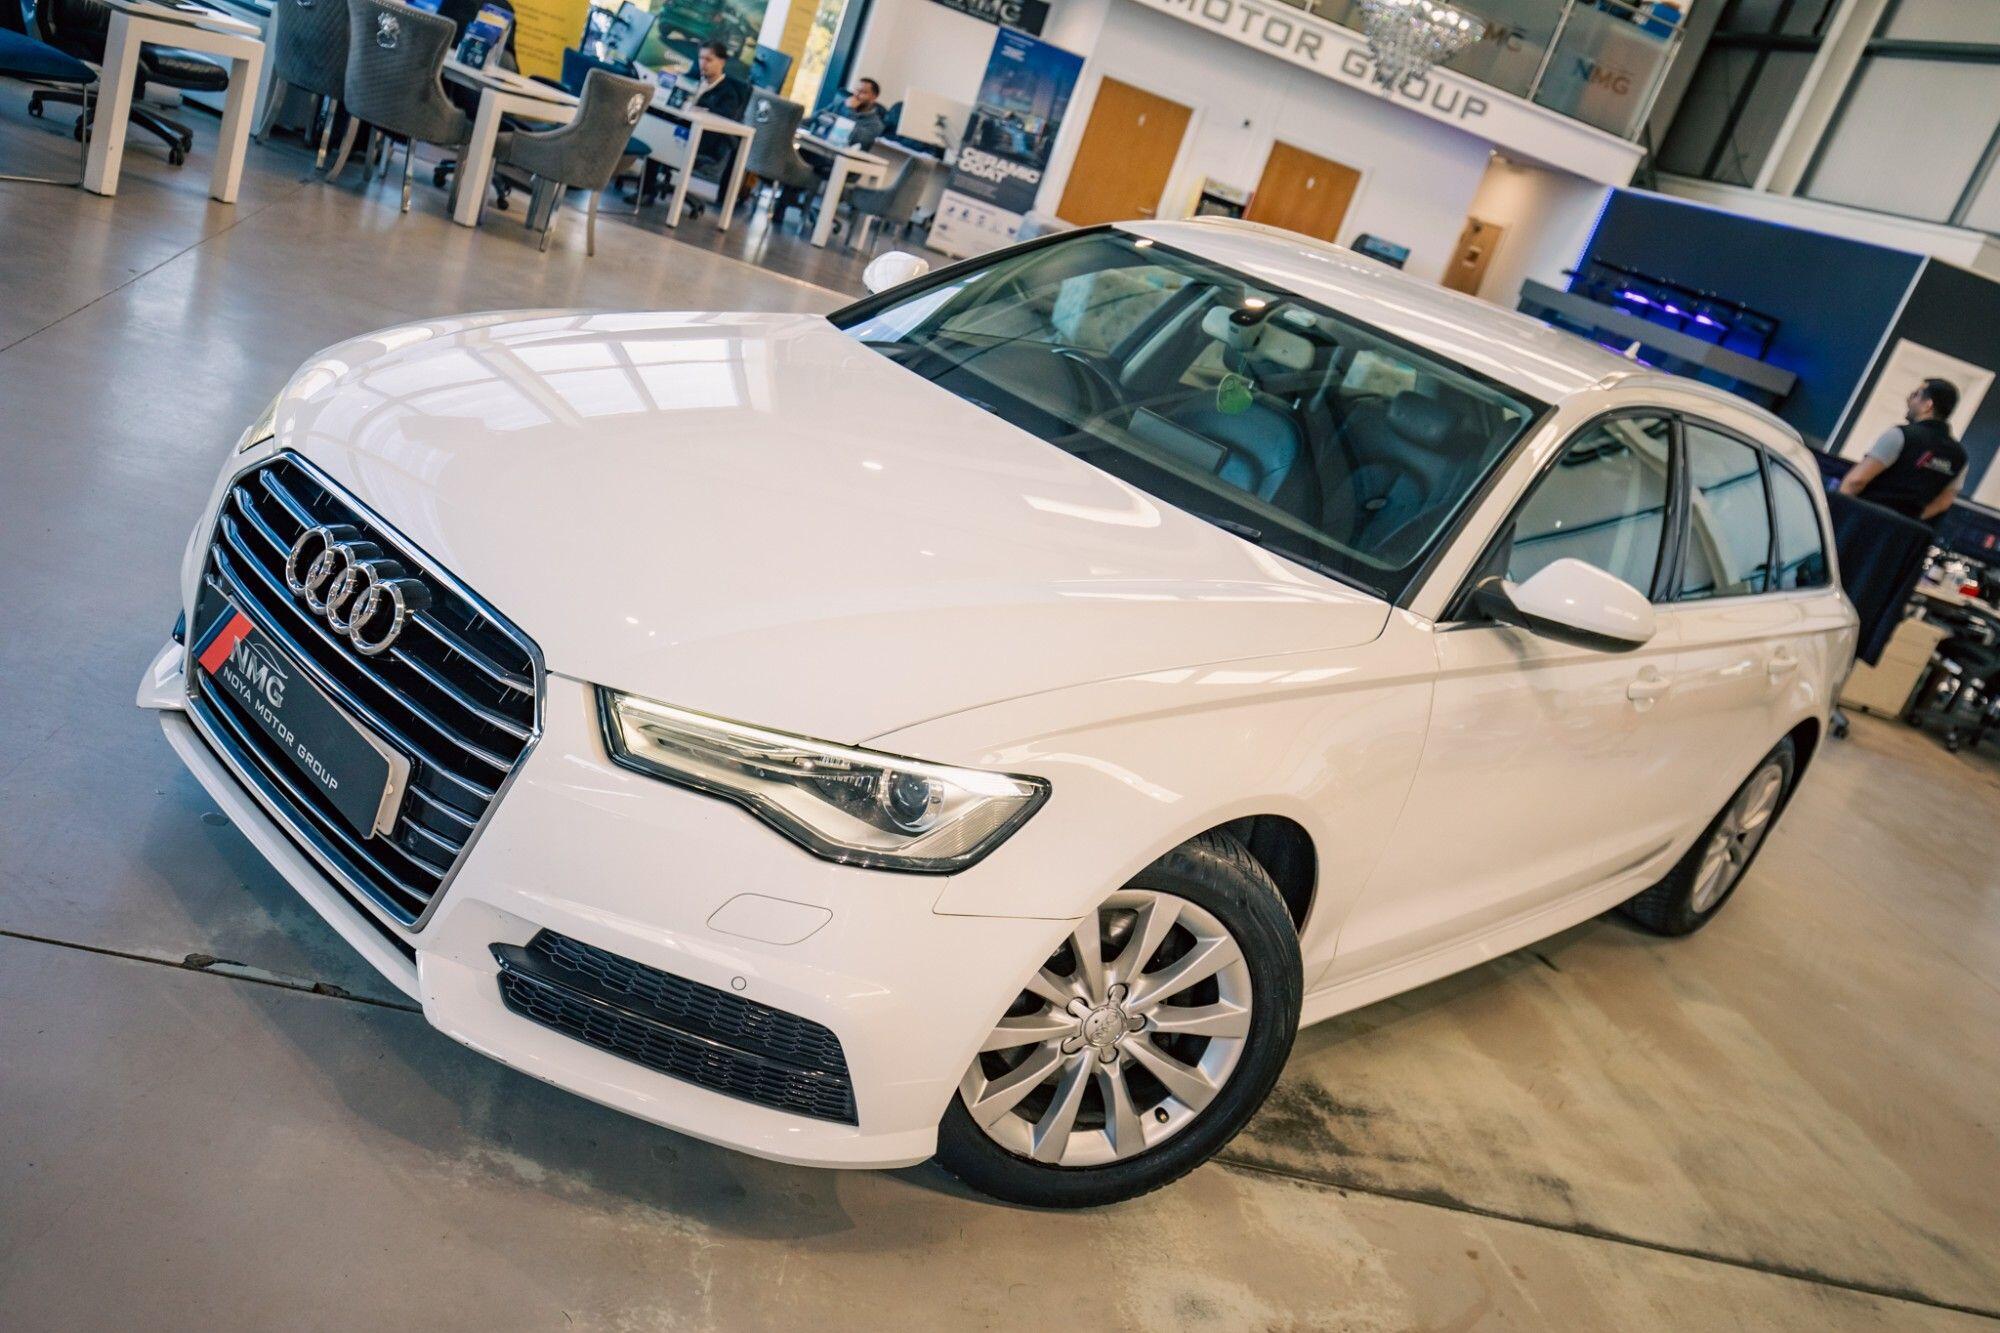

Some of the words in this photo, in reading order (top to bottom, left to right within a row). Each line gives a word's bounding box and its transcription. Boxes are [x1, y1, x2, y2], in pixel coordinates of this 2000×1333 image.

[1574, 57, 1631, 96] NMG
[228, 635, 286, 708] NMG
[223, 666, 251, 703] NOYA
[255, 698, 295, 747] MOTOR
[297, 743, 338, 790] GROUP
